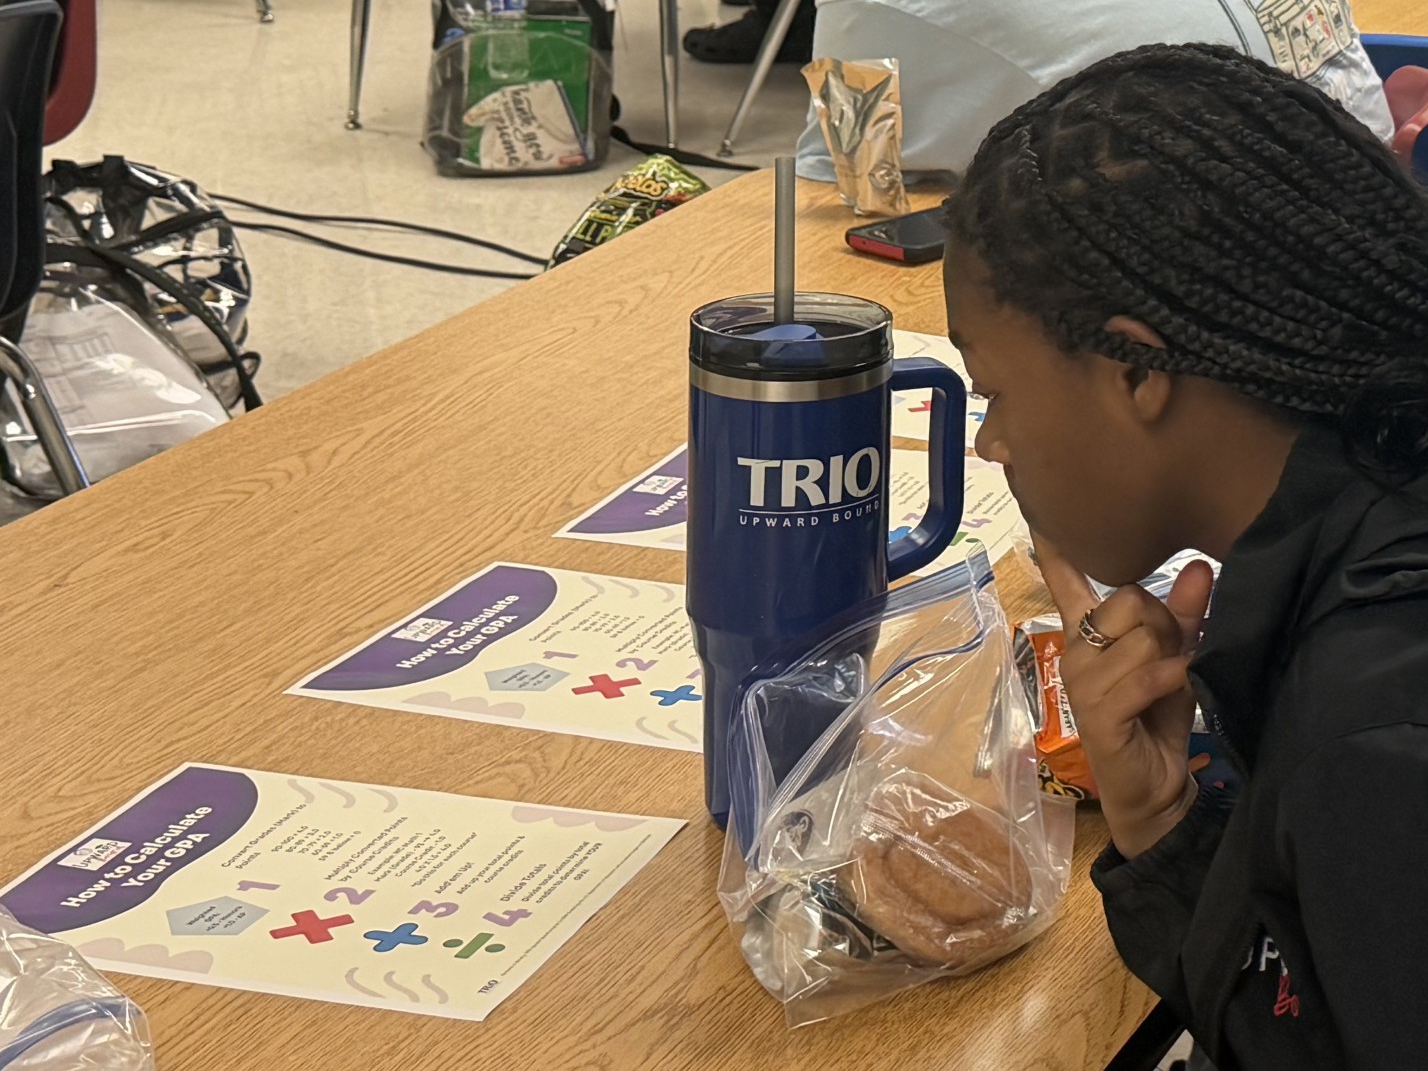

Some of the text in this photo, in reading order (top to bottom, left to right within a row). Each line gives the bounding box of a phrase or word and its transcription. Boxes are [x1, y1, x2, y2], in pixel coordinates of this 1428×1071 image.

[737, 446, 880, 507] TRIO
[739, 500, 880, 527] UPWARD BOUND
[396, 648, 437, 668] How
[431, 638, 454, 648] to
[447, 595, 519, 637] Calculate
[445, 616, 518, 654] Your GPA
[543, 651, 579, 659] 1
[615, 658, 659, 671] 2
[60, 880, 111, 907] How
[104, 865, 132, 878] to
[125, 807, 212, 863] Calculate
[121, 834, 210, 886] Your GPA
[236, 880, 281, 891] 1
[323, 887, 376, 905] 2
[407, 900, 459, 918] 3
[482, 909, 533, 927] 4
